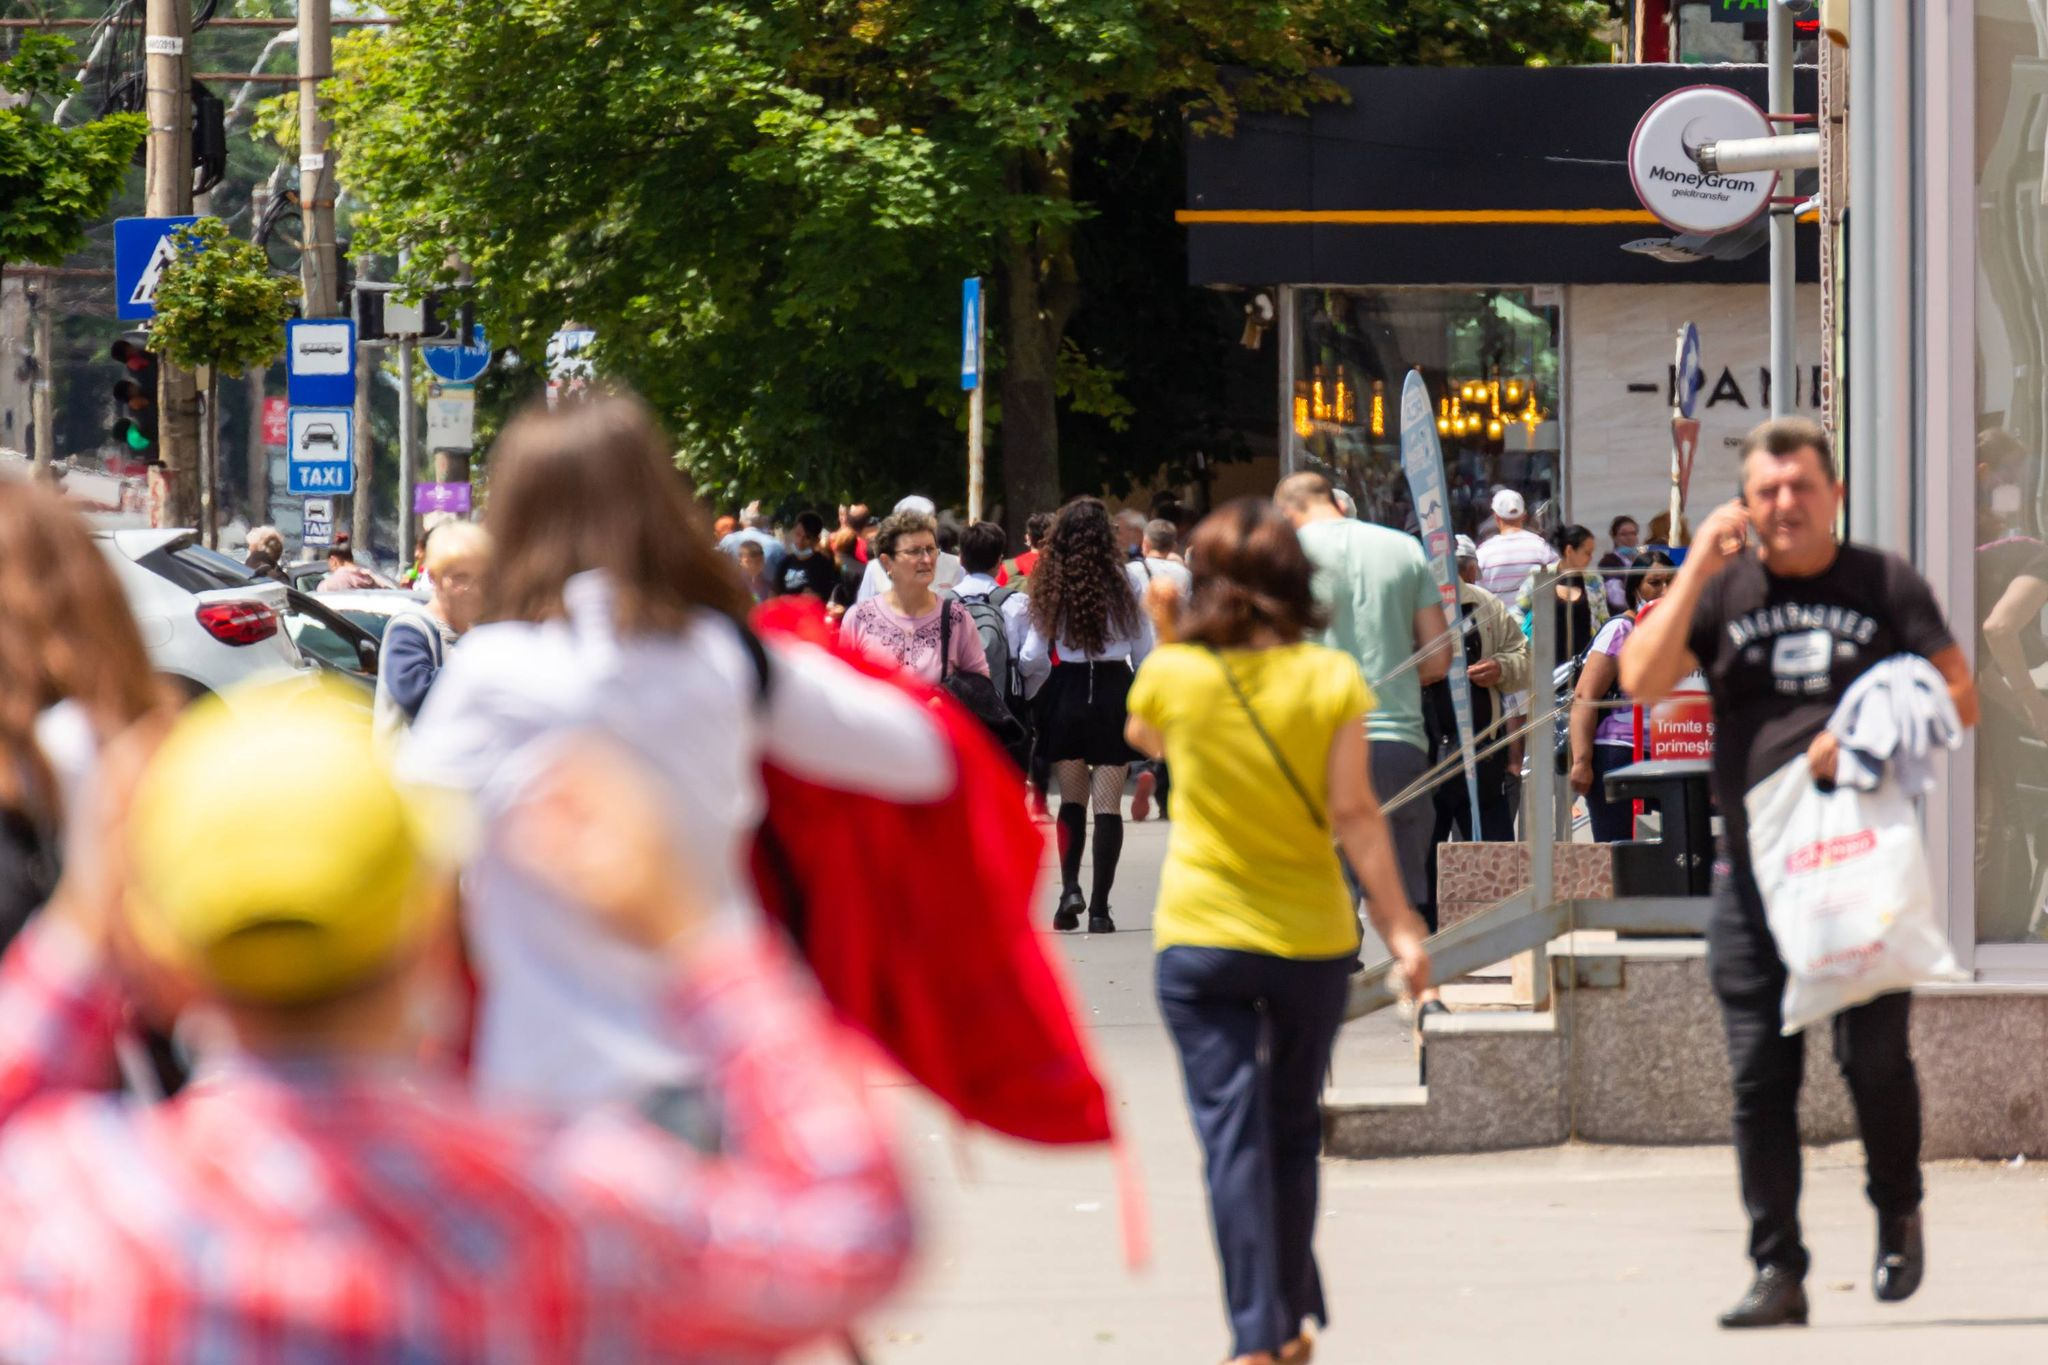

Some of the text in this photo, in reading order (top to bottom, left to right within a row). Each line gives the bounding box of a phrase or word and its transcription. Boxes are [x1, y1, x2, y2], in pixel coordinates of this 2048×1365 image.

[1649, 166, 1755, 193] MoneyGram
[298, 466, 344, 488] TAXI
[303, 522, 332, 537] TAXI
[1656, 719, 1716, 736] Trimite ș
